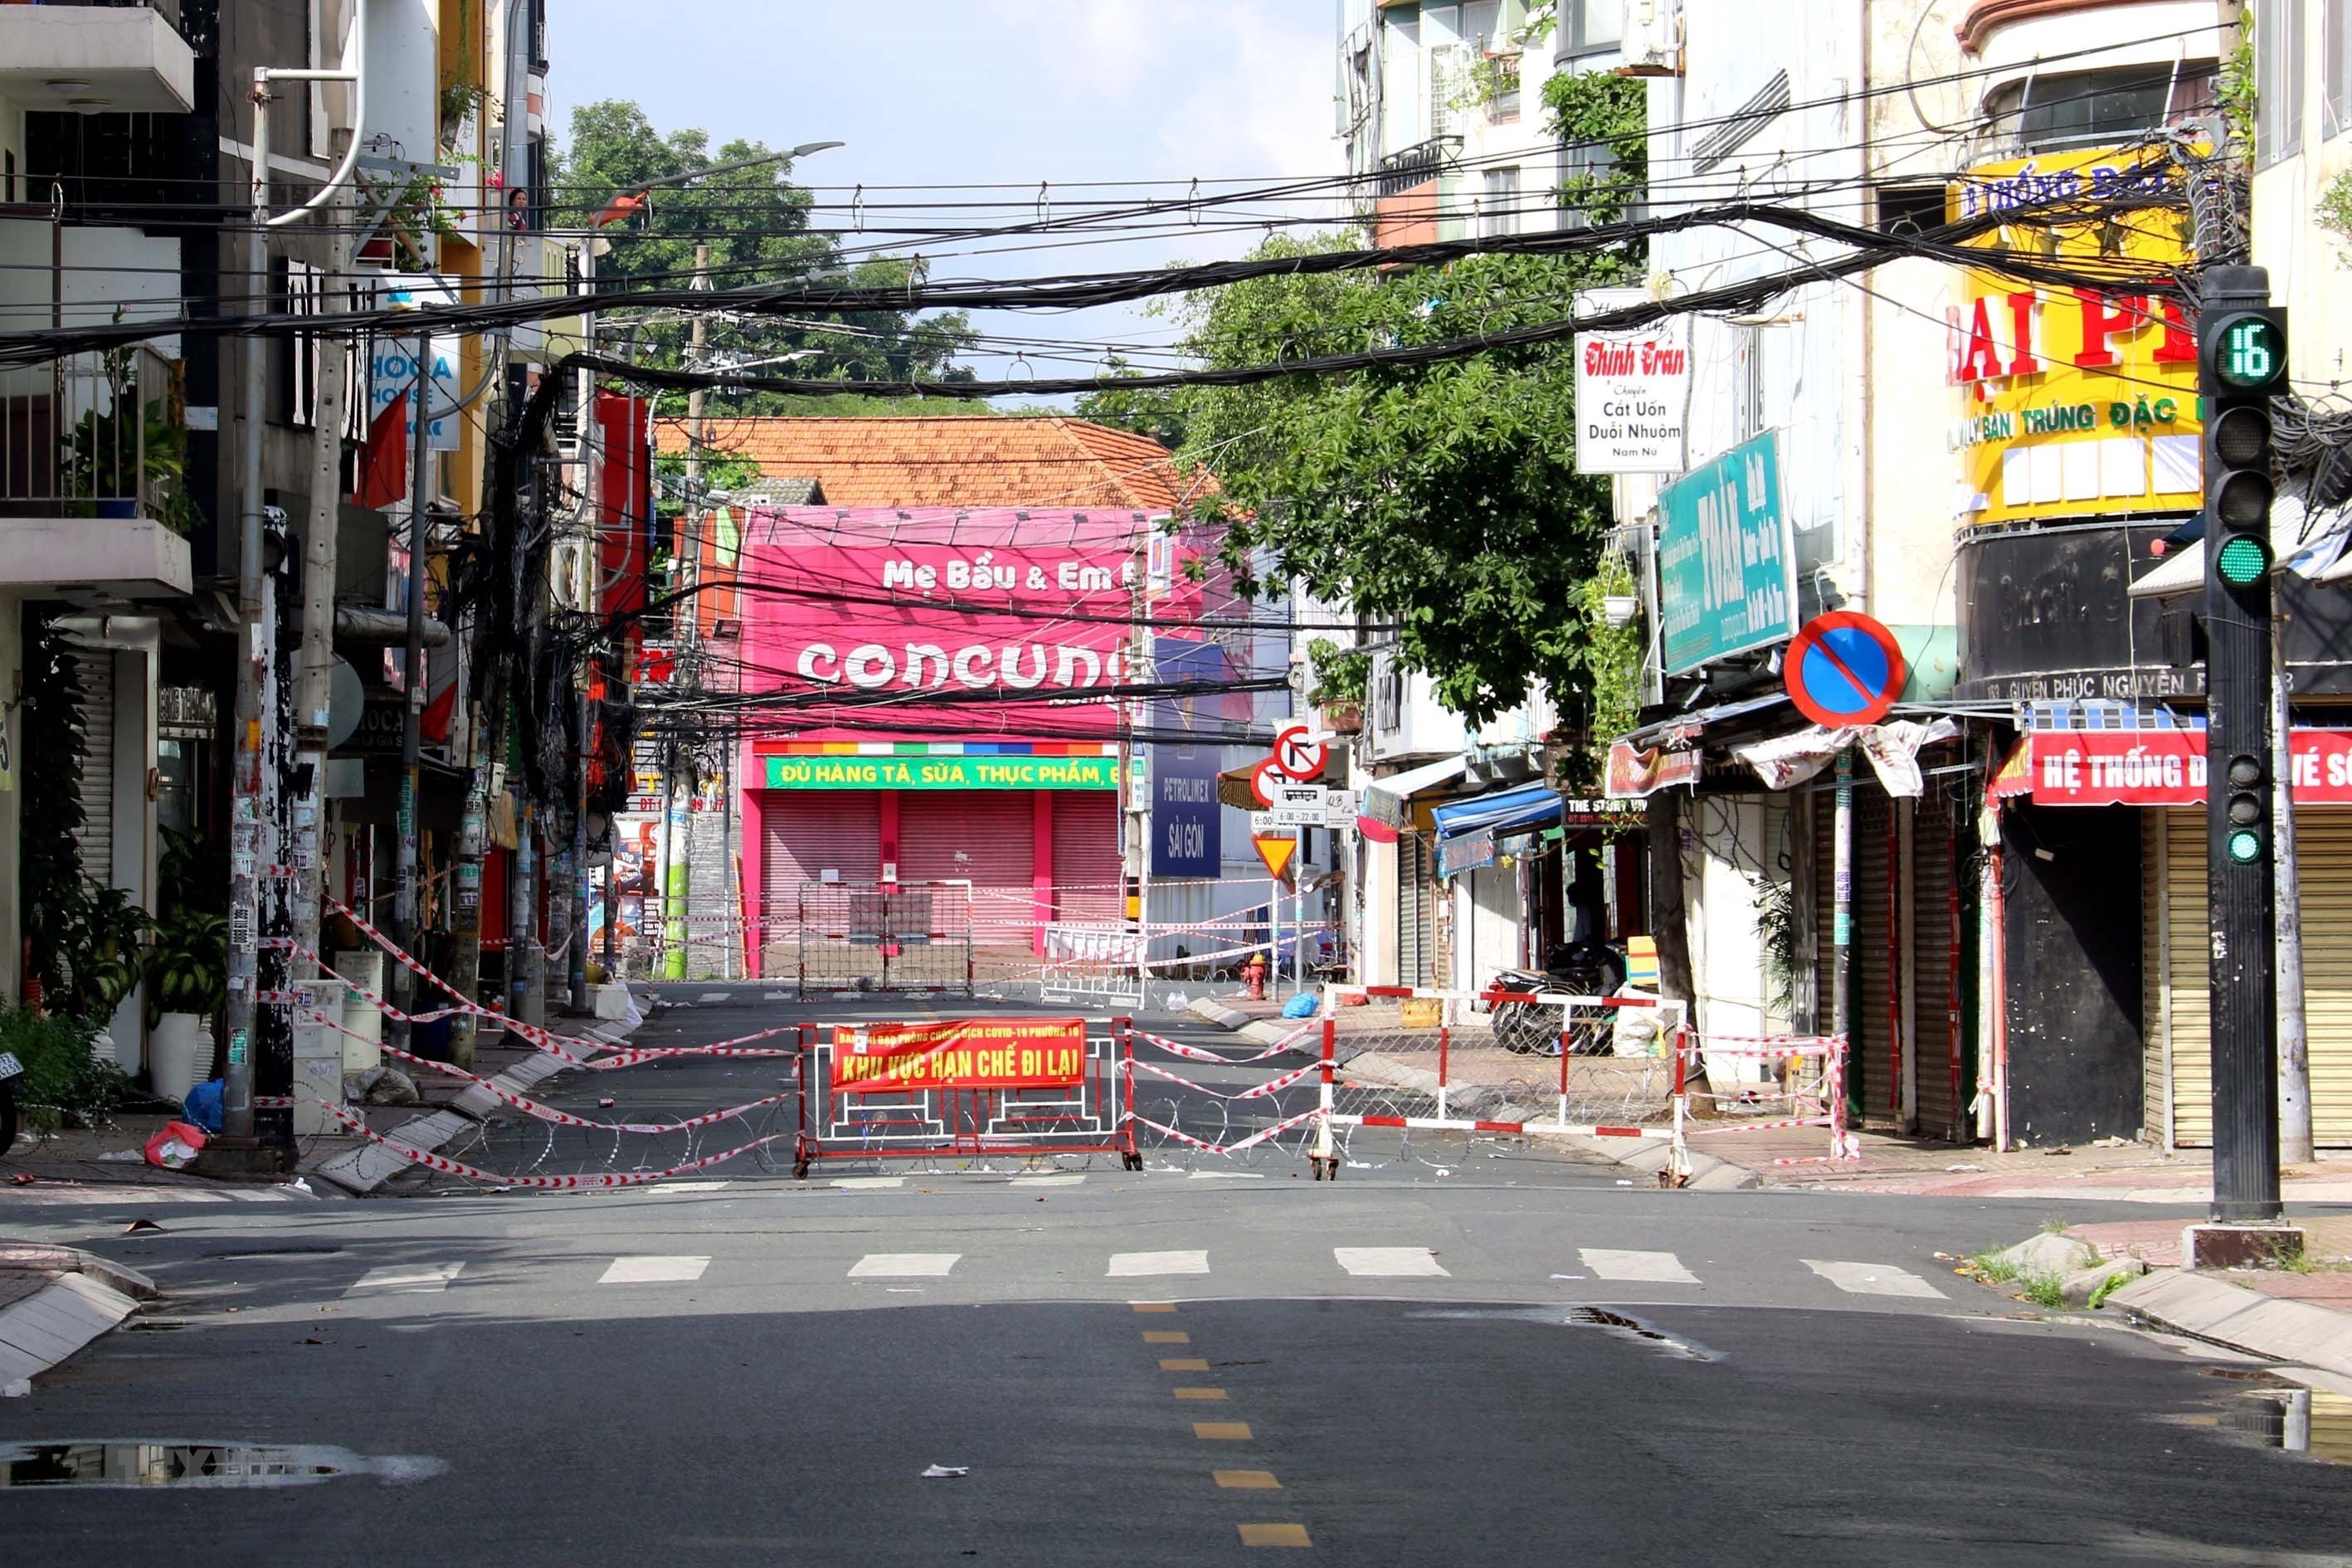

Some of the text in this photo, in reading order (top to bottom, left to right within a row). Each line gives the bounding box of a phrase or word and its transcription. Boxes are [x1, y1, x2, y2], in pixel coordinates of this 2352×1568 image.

[1585, 341, 1635, 385] Thịnh
[2233, 324, 2269, 377] 16
[1636, 399, 1666, 416] Uốn
[1590, 421, 1681, 442] Duỗi Nhuộm
[1613, 447, 1638, 456] Nam
[883, 560, 936, 597] Mẹ
[947, 551, 1015, 590] Bầu
[1058, 562, 1113, 590] Em
[2053, 674, 2095, 698] PHÚC
[781, 760, 812, 782] ĐỦ
[816, 761, 877, 783] HÀNG
[976, 764, 1033, 786] THỰC
[2043, 748, 2081, 794] HỆ
[2087, 745, 2182, 787] THỐNG
[1164, 777, 1209, 803] PETROLIMEX
[1568, 799, 1590, 812] THE
[1168, 816, 1204, 859] SÀI GÒN
[985, 1027, 1028, 1039] COVID-19
[1069, 1026, 1079, 1037] 10
[843, 1040, 1078, 1085] KHU VỰC HẠN CHẾ ĐI LẠI
